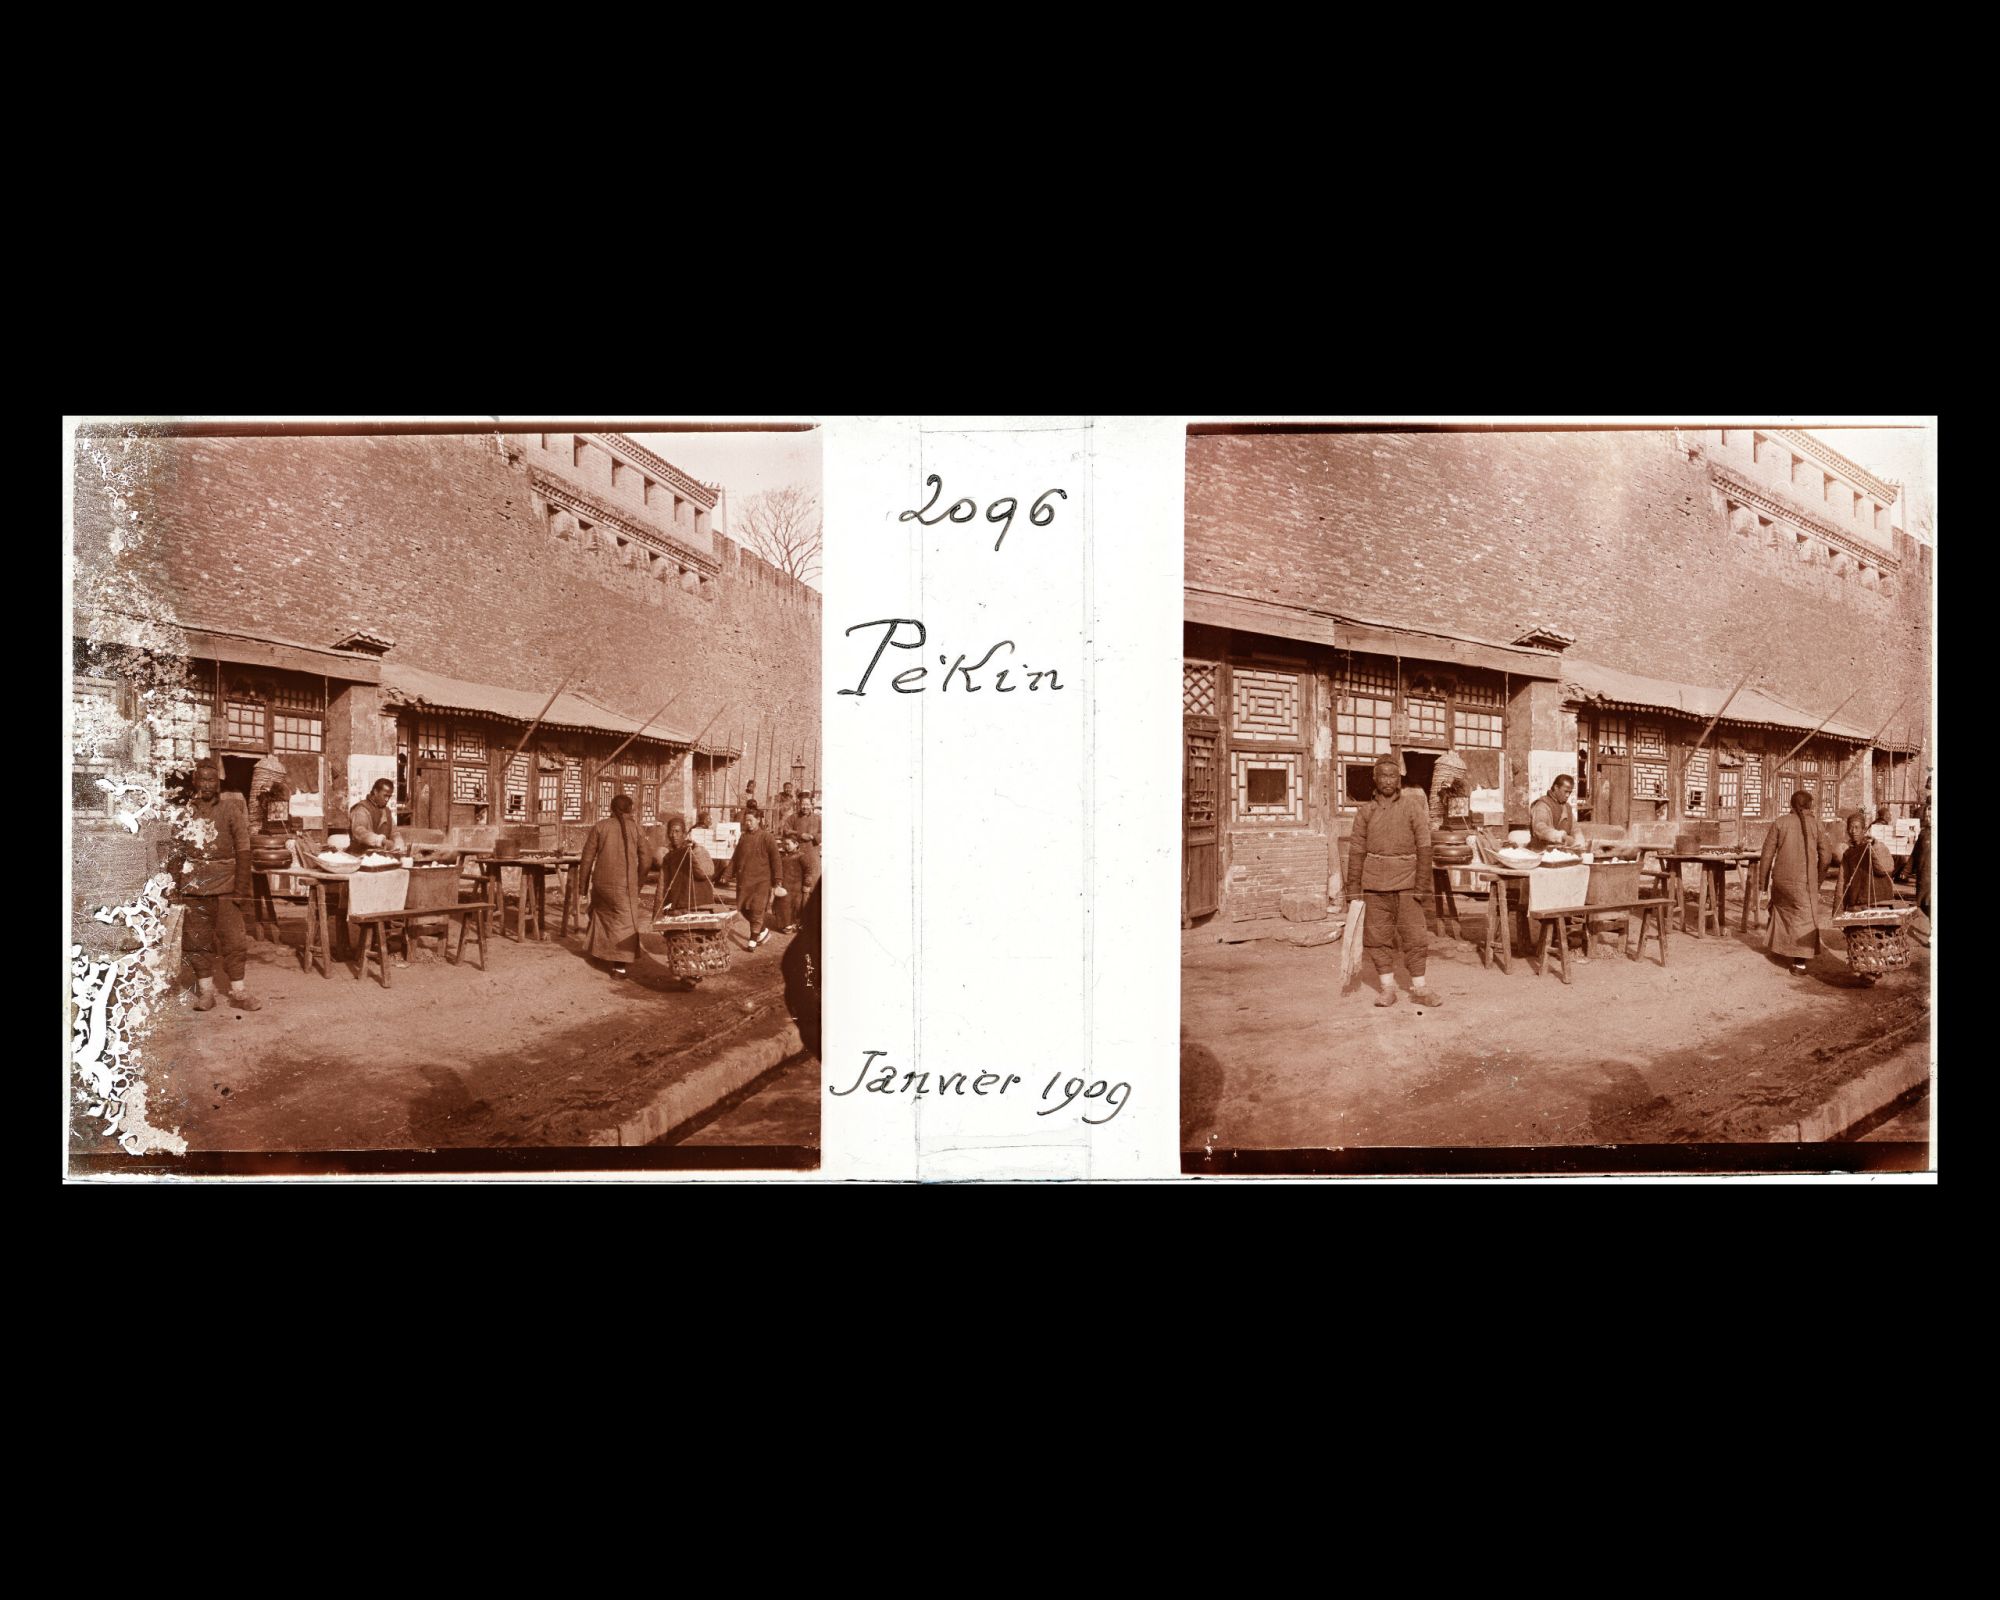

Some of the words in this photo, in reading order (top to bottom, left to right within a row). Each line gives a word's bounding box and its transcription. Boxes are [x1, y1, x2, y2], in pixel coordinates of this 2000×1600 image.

[899, 474, 1067, 552] 2096
[829, 1050, 1021, 1096] Janvier
[1036, 1071, 1132, 1125] 1909
